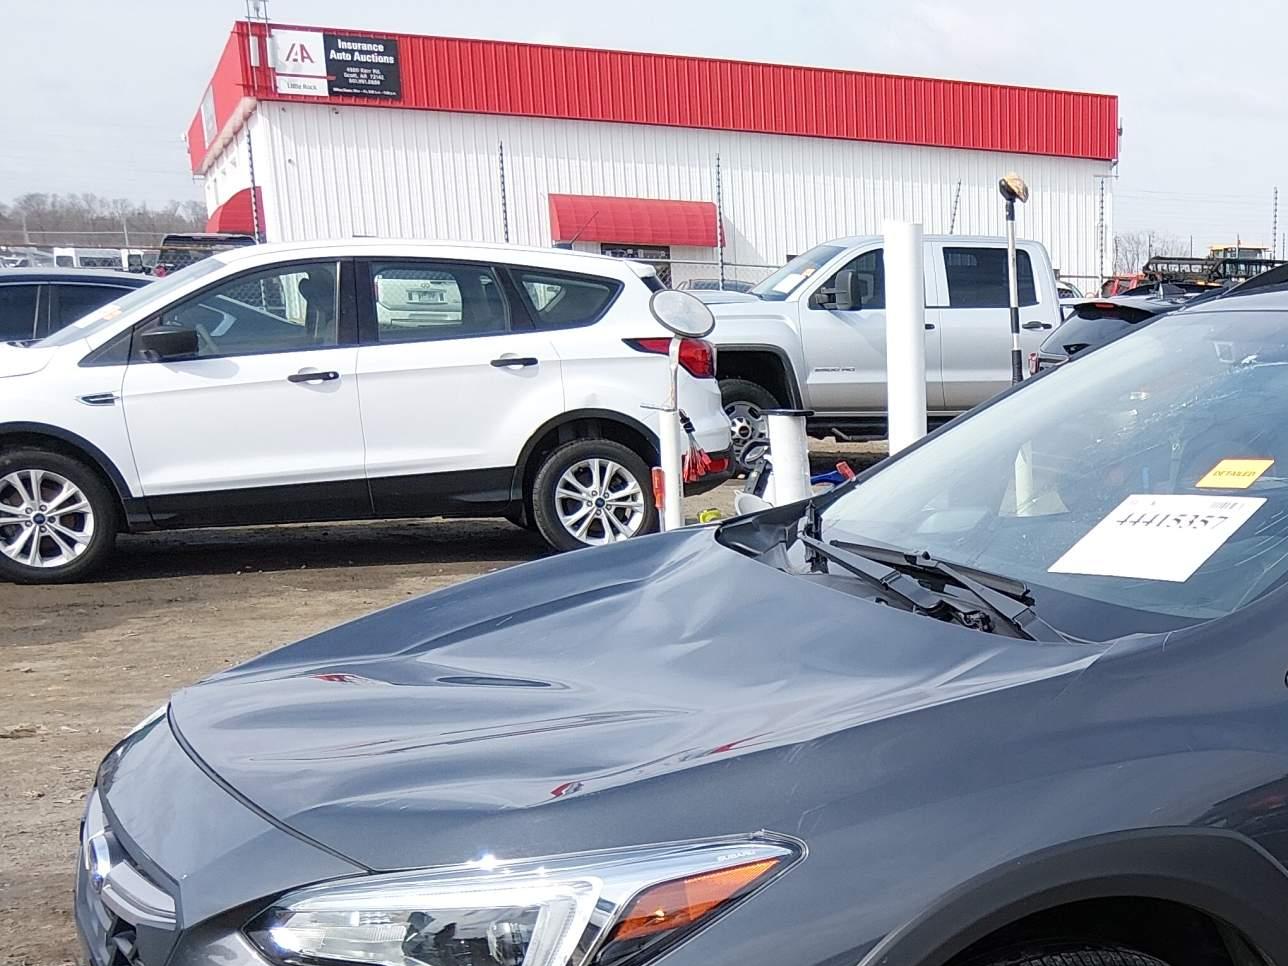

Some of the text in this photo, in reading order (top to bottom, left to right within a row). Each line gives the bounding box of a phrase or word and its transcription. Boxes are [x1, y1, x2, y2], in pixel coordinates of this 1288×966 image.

[337, 39, 384, 51] Insurance
[329, 50, 395, 64] Auto Auctions
[1116, 513, 1229, 529] 44415357
